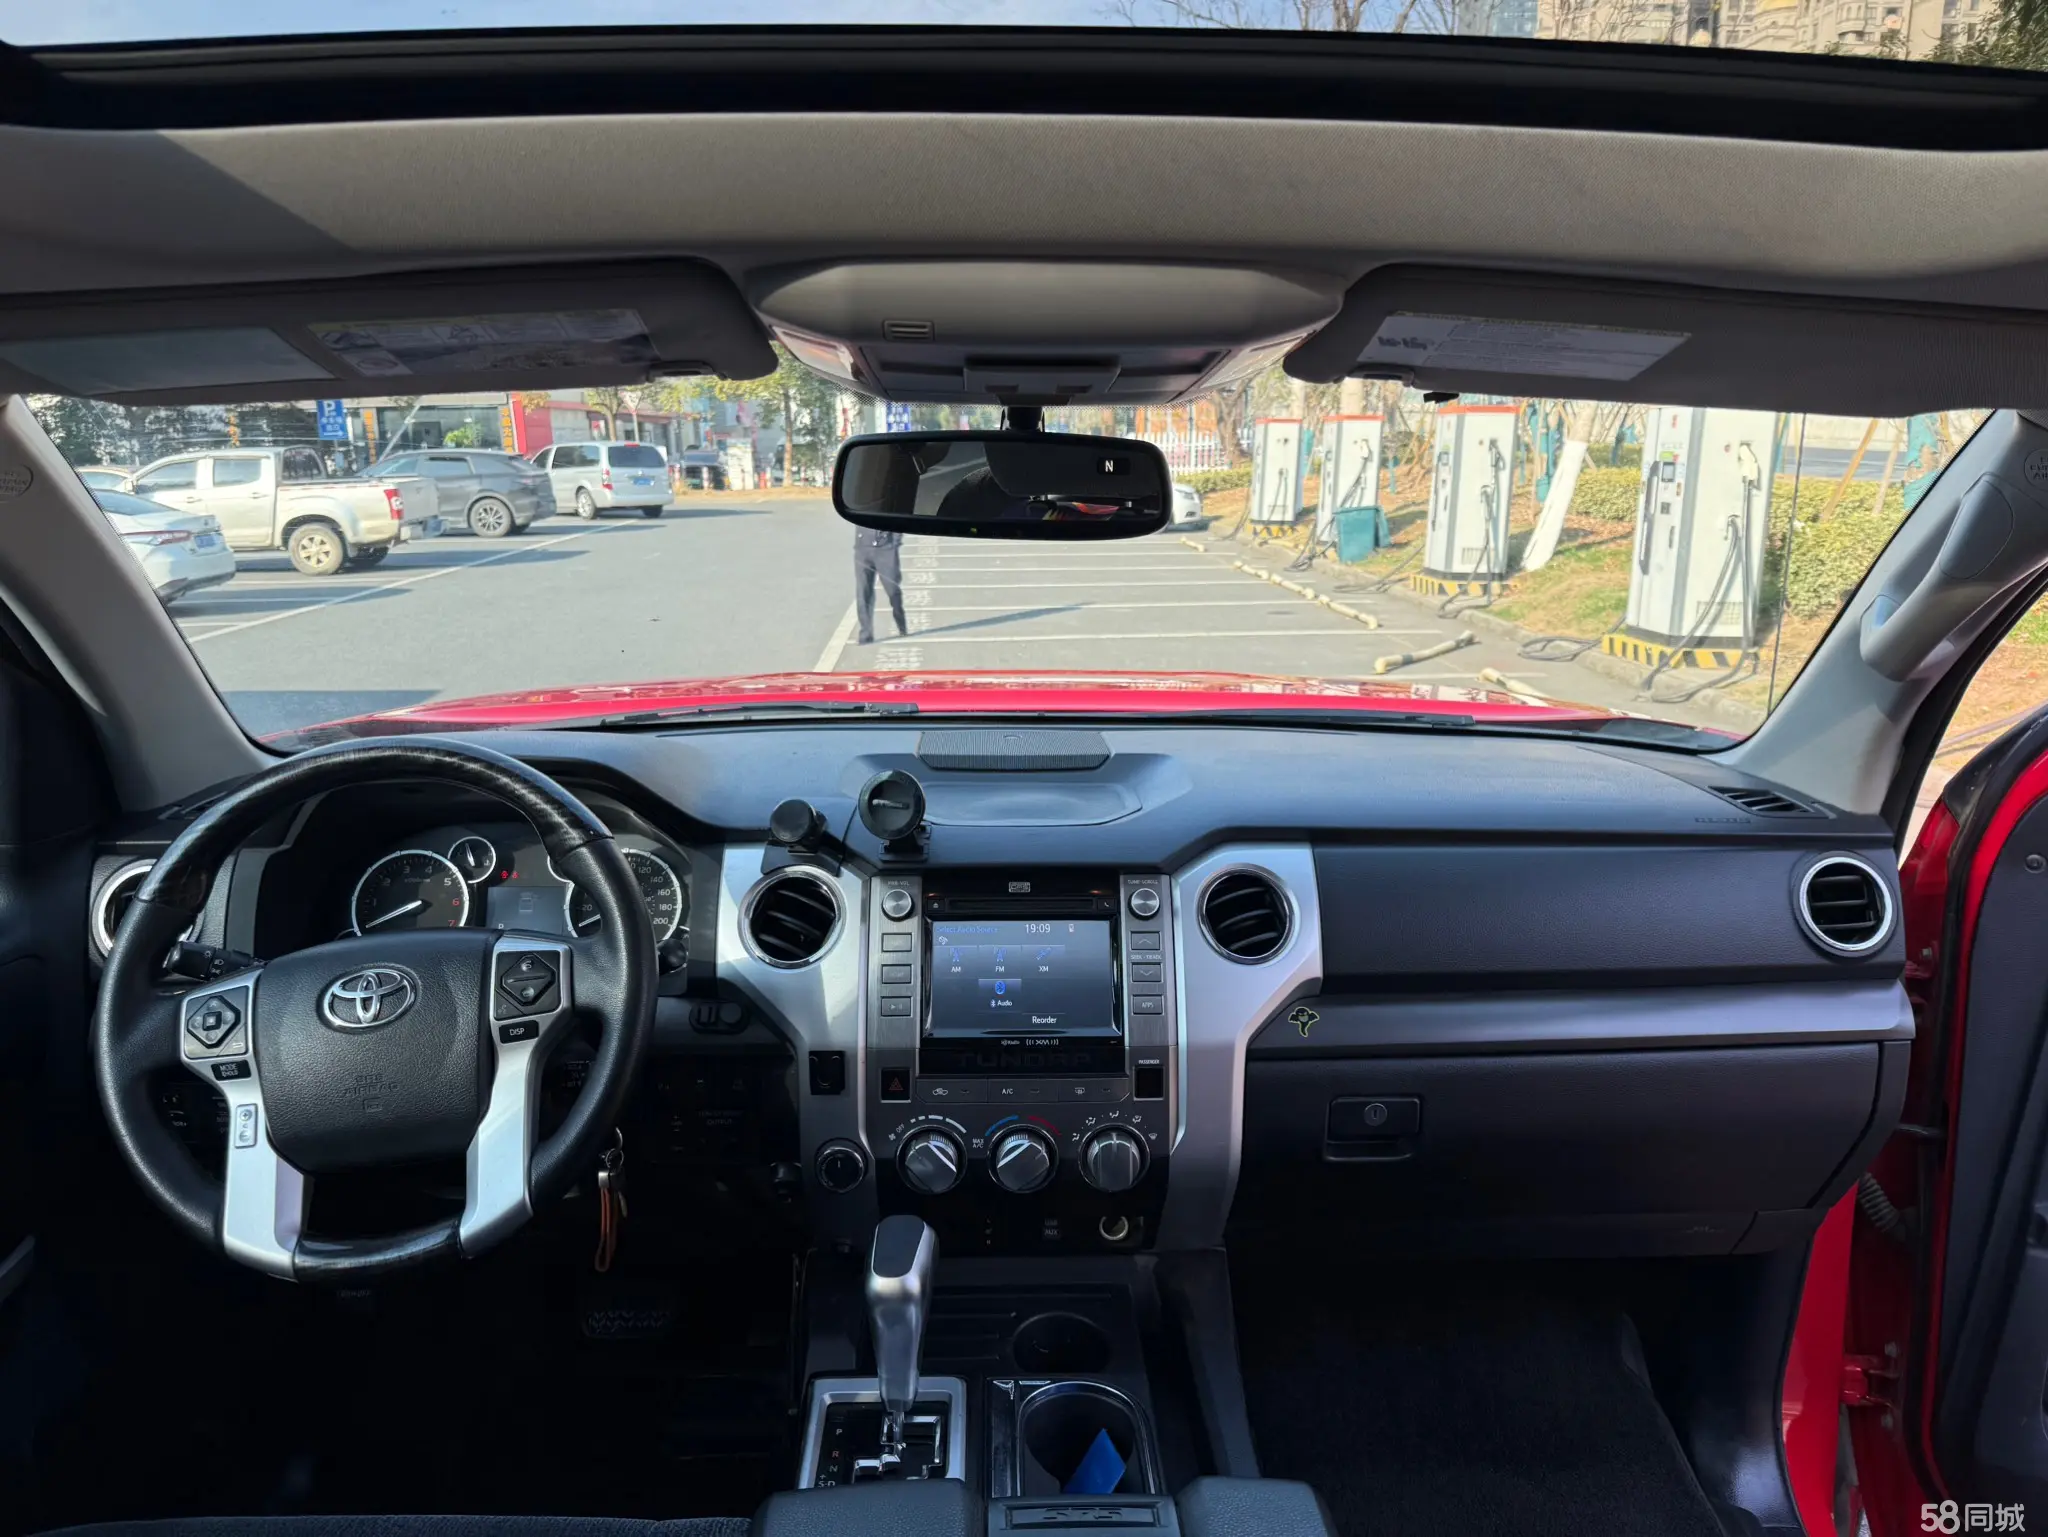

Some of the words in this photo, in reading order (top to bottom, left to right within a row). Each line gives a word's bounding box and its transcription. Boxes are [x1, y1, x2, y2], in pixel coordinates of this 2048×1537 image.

[323, 400, 336, 417] P
[1105, 459, 1114, 472] N
[443, 877, 452, 886] 5
[657, 888, 671, 896] 160
[452, 898, 460, 906] 6
[659, 903, 673, 911] 180
[653, 917, 669, 925] 200
[1025, 923, 1051, 934] 19:09
[995, 965, 1005, 973] FM
[1038, 965, 1049, 973] XM
[997, 999, 1013, 1007] Audio
[1032, 1015, 1057, 1024] Reorder
[509, 1027, 525, 1036] DISP
